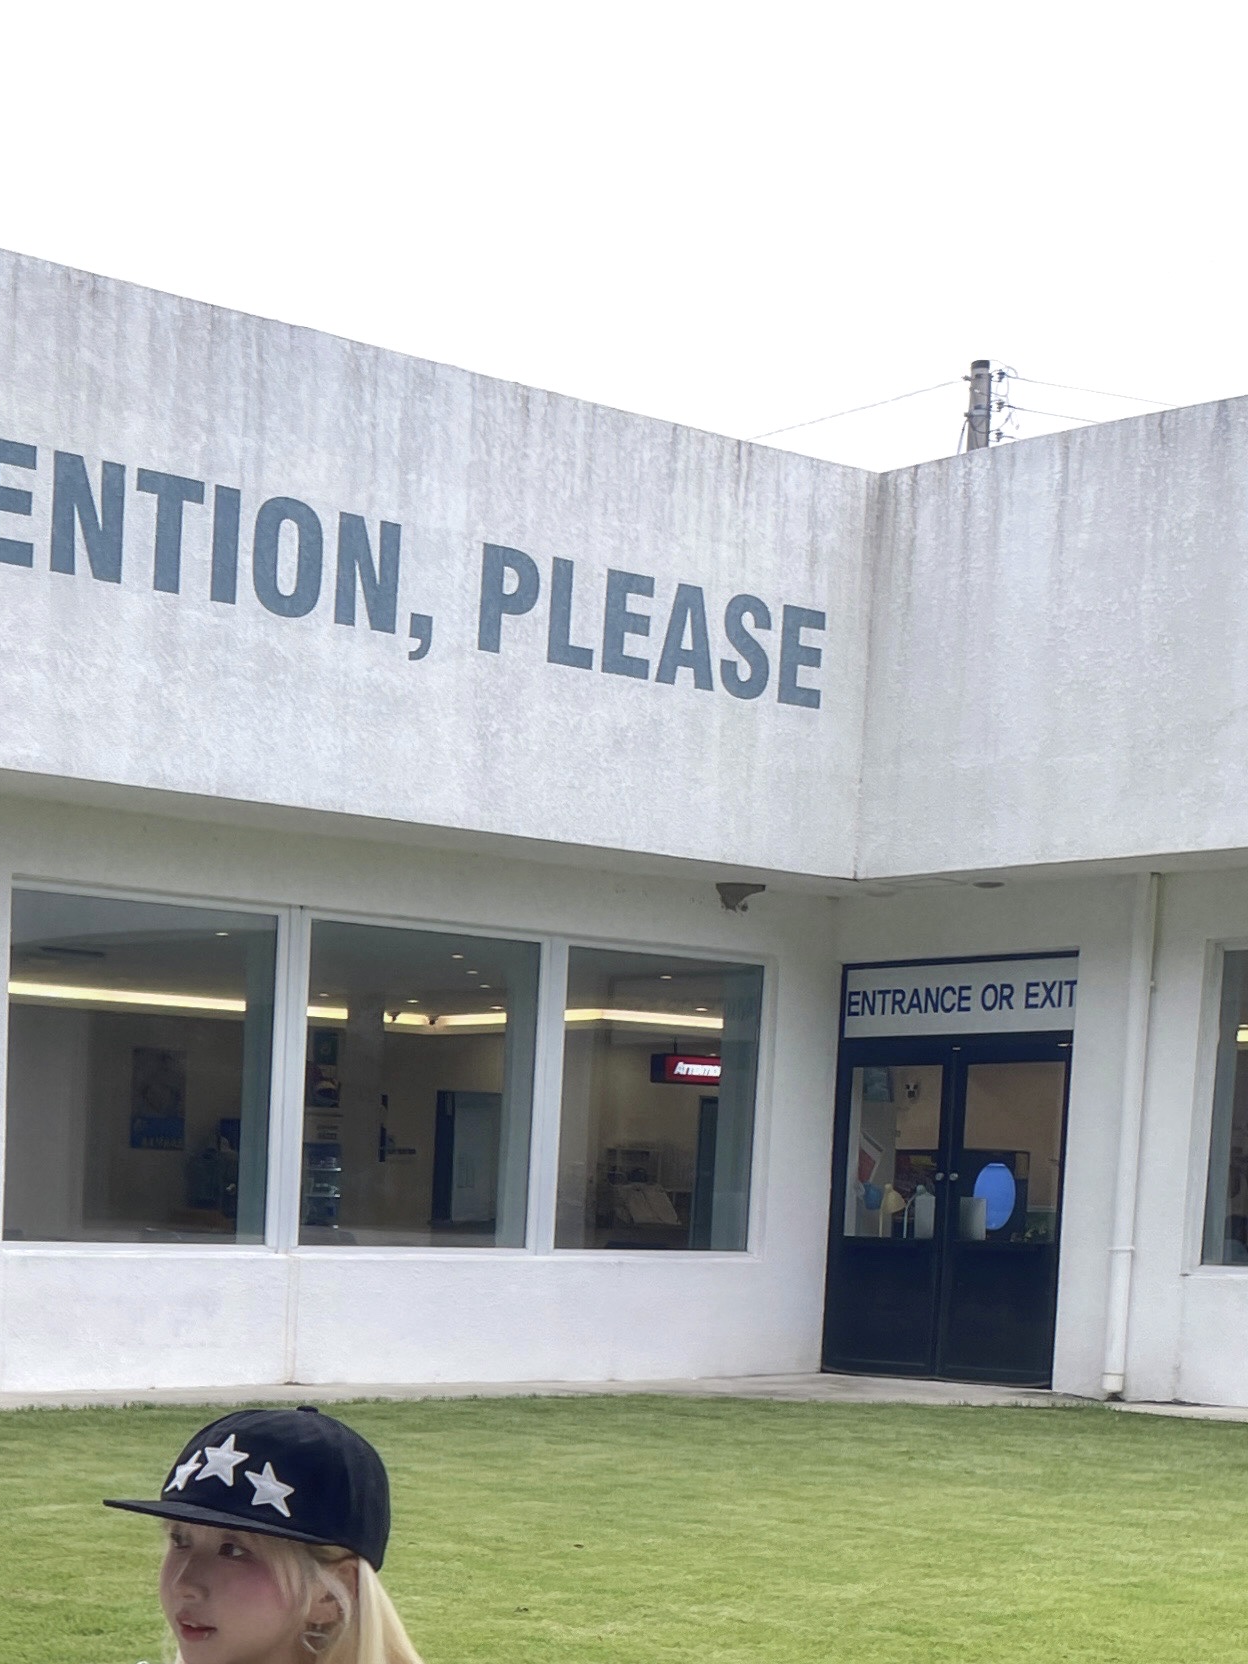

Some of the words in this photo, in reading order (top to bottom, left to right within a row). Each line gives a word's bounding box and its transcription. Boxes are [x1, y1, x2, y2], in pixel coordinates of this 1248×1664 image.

[477, 541, 827, 710] PLEASE
[847, 985, 973, 1017] ENTRANCE
[981, 983, 1014, 1011] OR
[1024, 979, 1078, 1010] EXIT
